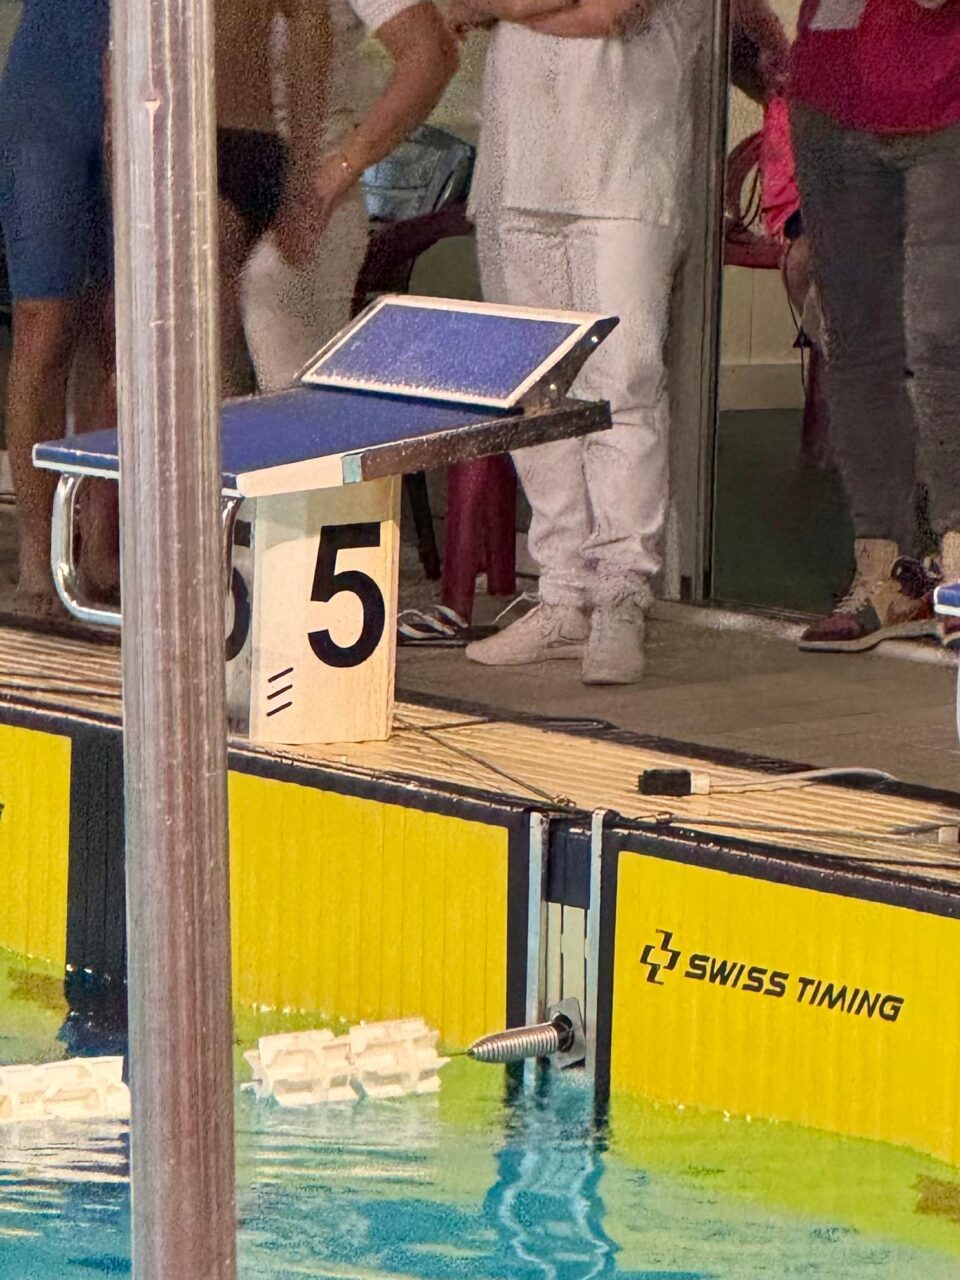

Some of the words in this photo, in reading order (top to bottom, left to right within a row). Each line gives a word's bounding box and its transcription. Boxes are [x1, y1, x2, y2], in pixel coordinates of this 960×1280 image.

[307, 521, 386, 668] 5
[684, 953, 790, 998] SWISS
[797, 976, 905, 1022] TIMING
